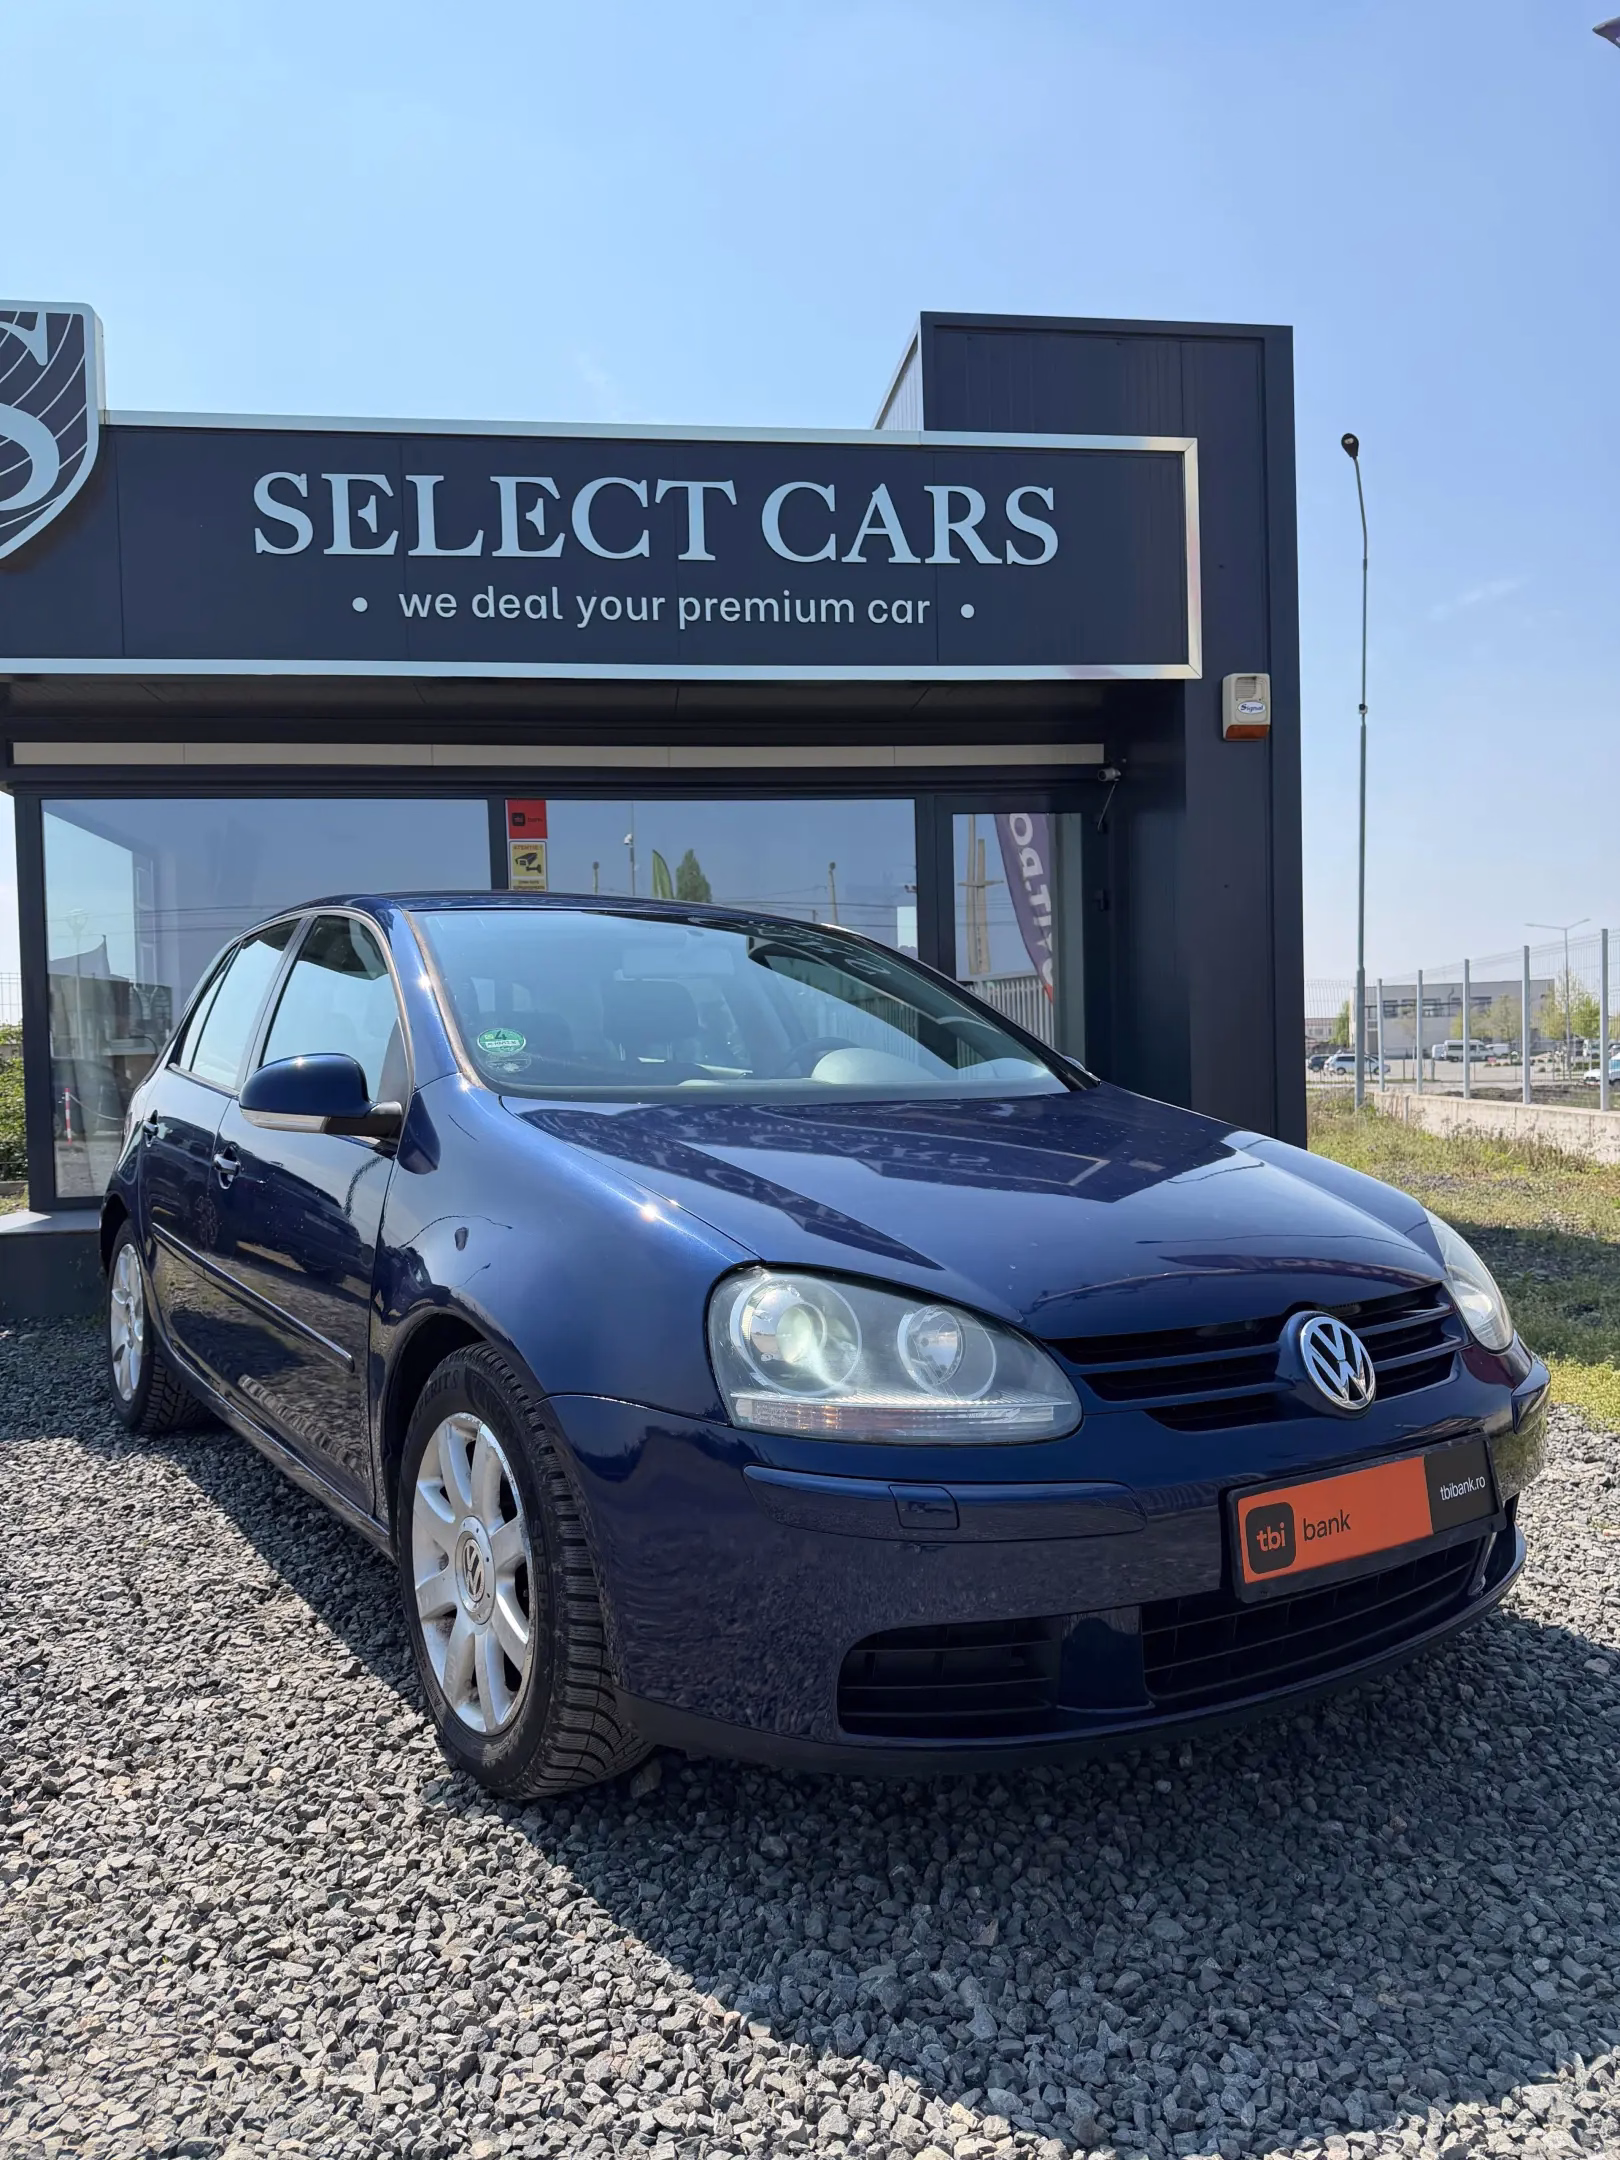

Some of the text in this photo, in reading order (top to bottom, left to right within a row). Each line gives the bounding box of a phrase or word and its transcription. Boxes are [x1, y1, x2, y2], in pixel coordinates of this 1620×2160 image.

[252, 471, 1060, 566] SELECT CARS
[398, 585, 931, 630] we deal your premium car
[1439, 1475, 1486, 1501] tbibank.ro
[1255, 1509, 1352, 1552] tbi bank
